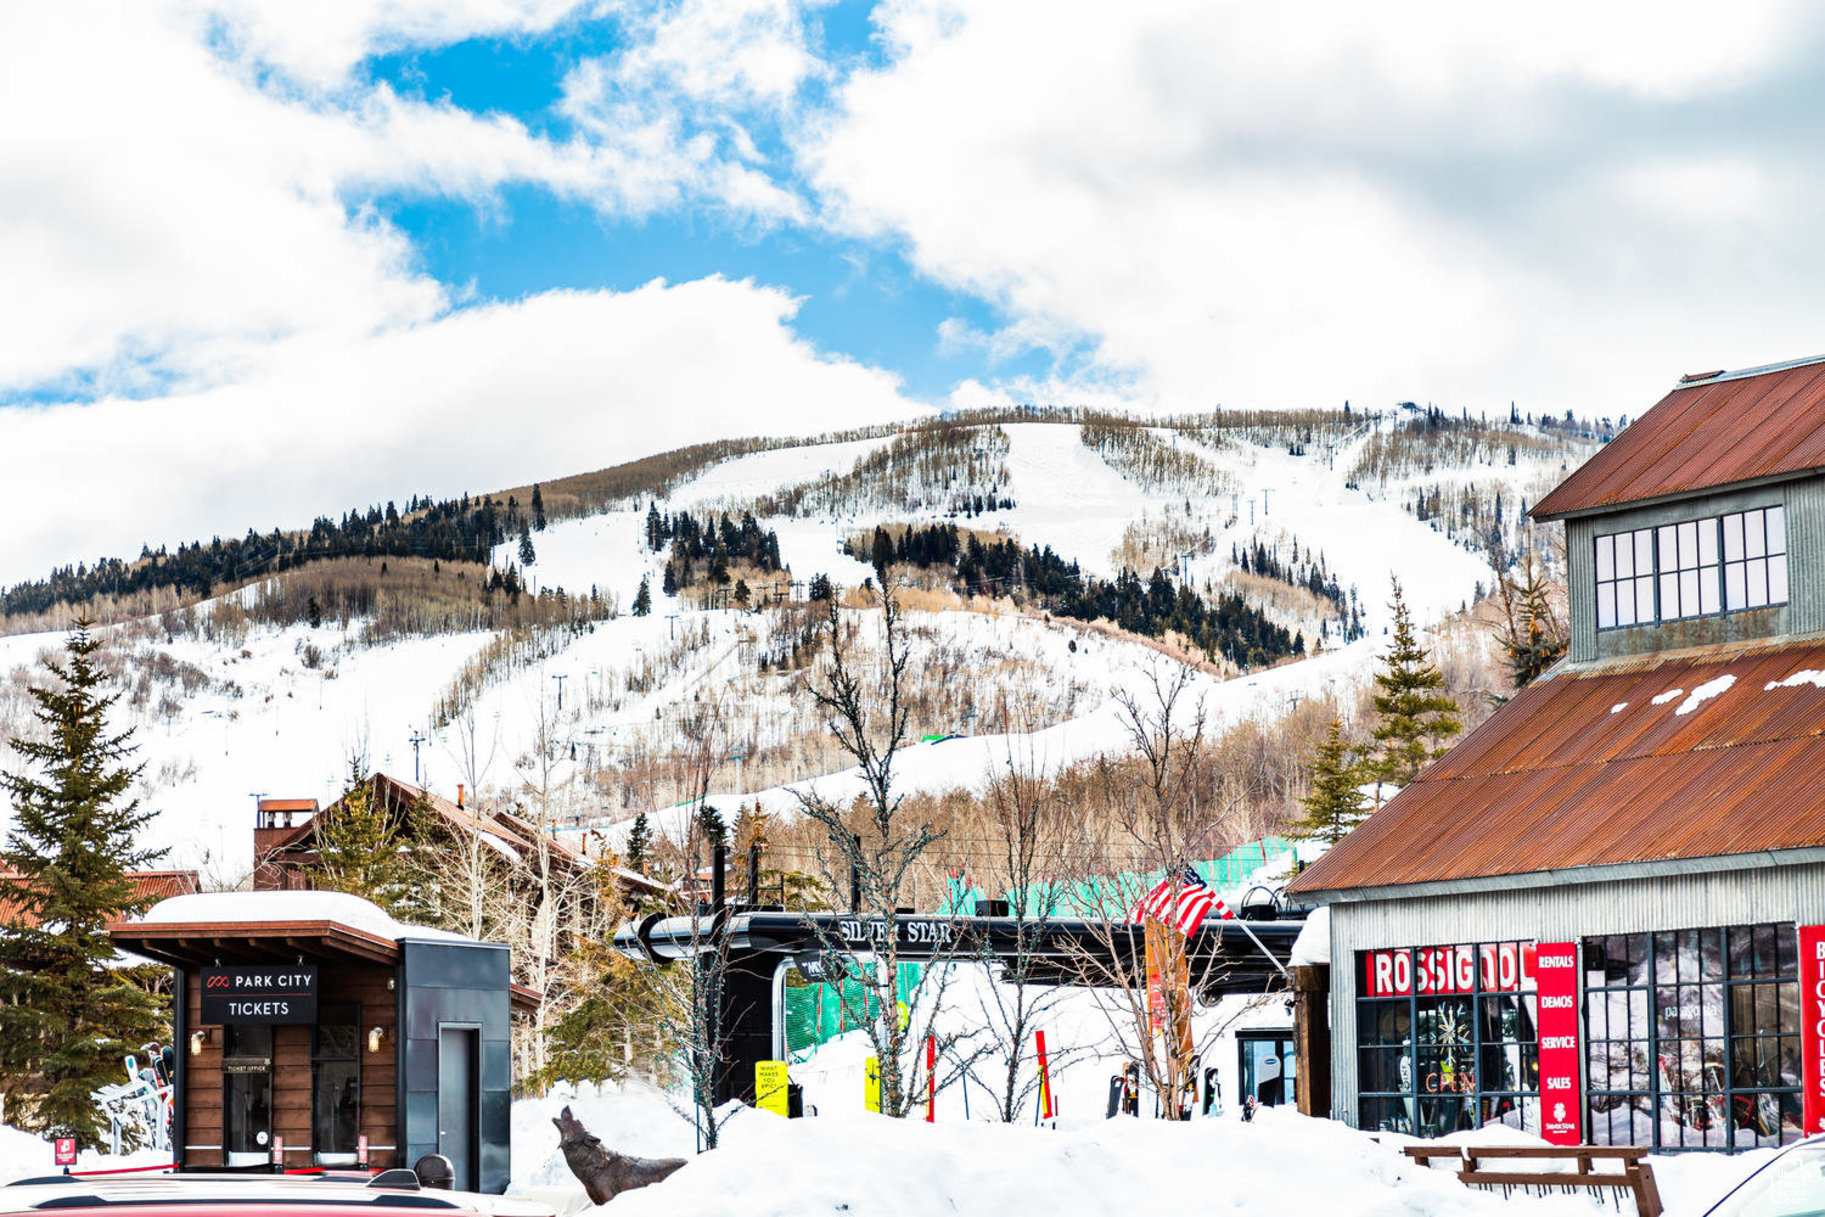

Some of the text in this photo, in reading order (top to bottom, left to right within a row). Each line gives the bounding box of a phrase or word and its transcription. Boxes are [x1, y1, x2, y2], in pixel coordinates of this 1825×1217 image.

[840, 920, 952, 943] SILVE STAR
[1375, 943, 1538, 994] ROSSIGNOL
[1538, 955, 1574, 969] RENTALS
[235, 974, 312, 988] PARK CITY
[228, 1002, 289, 1016] TICKETS
[1541, 995, 1573, 1009] DEMOS
[1664, 1002, 1717, 1020] paagoia
[1541, 1035, 1576, 1050] SERVICE
[1546, 1076, 1572, 1090] SALES
